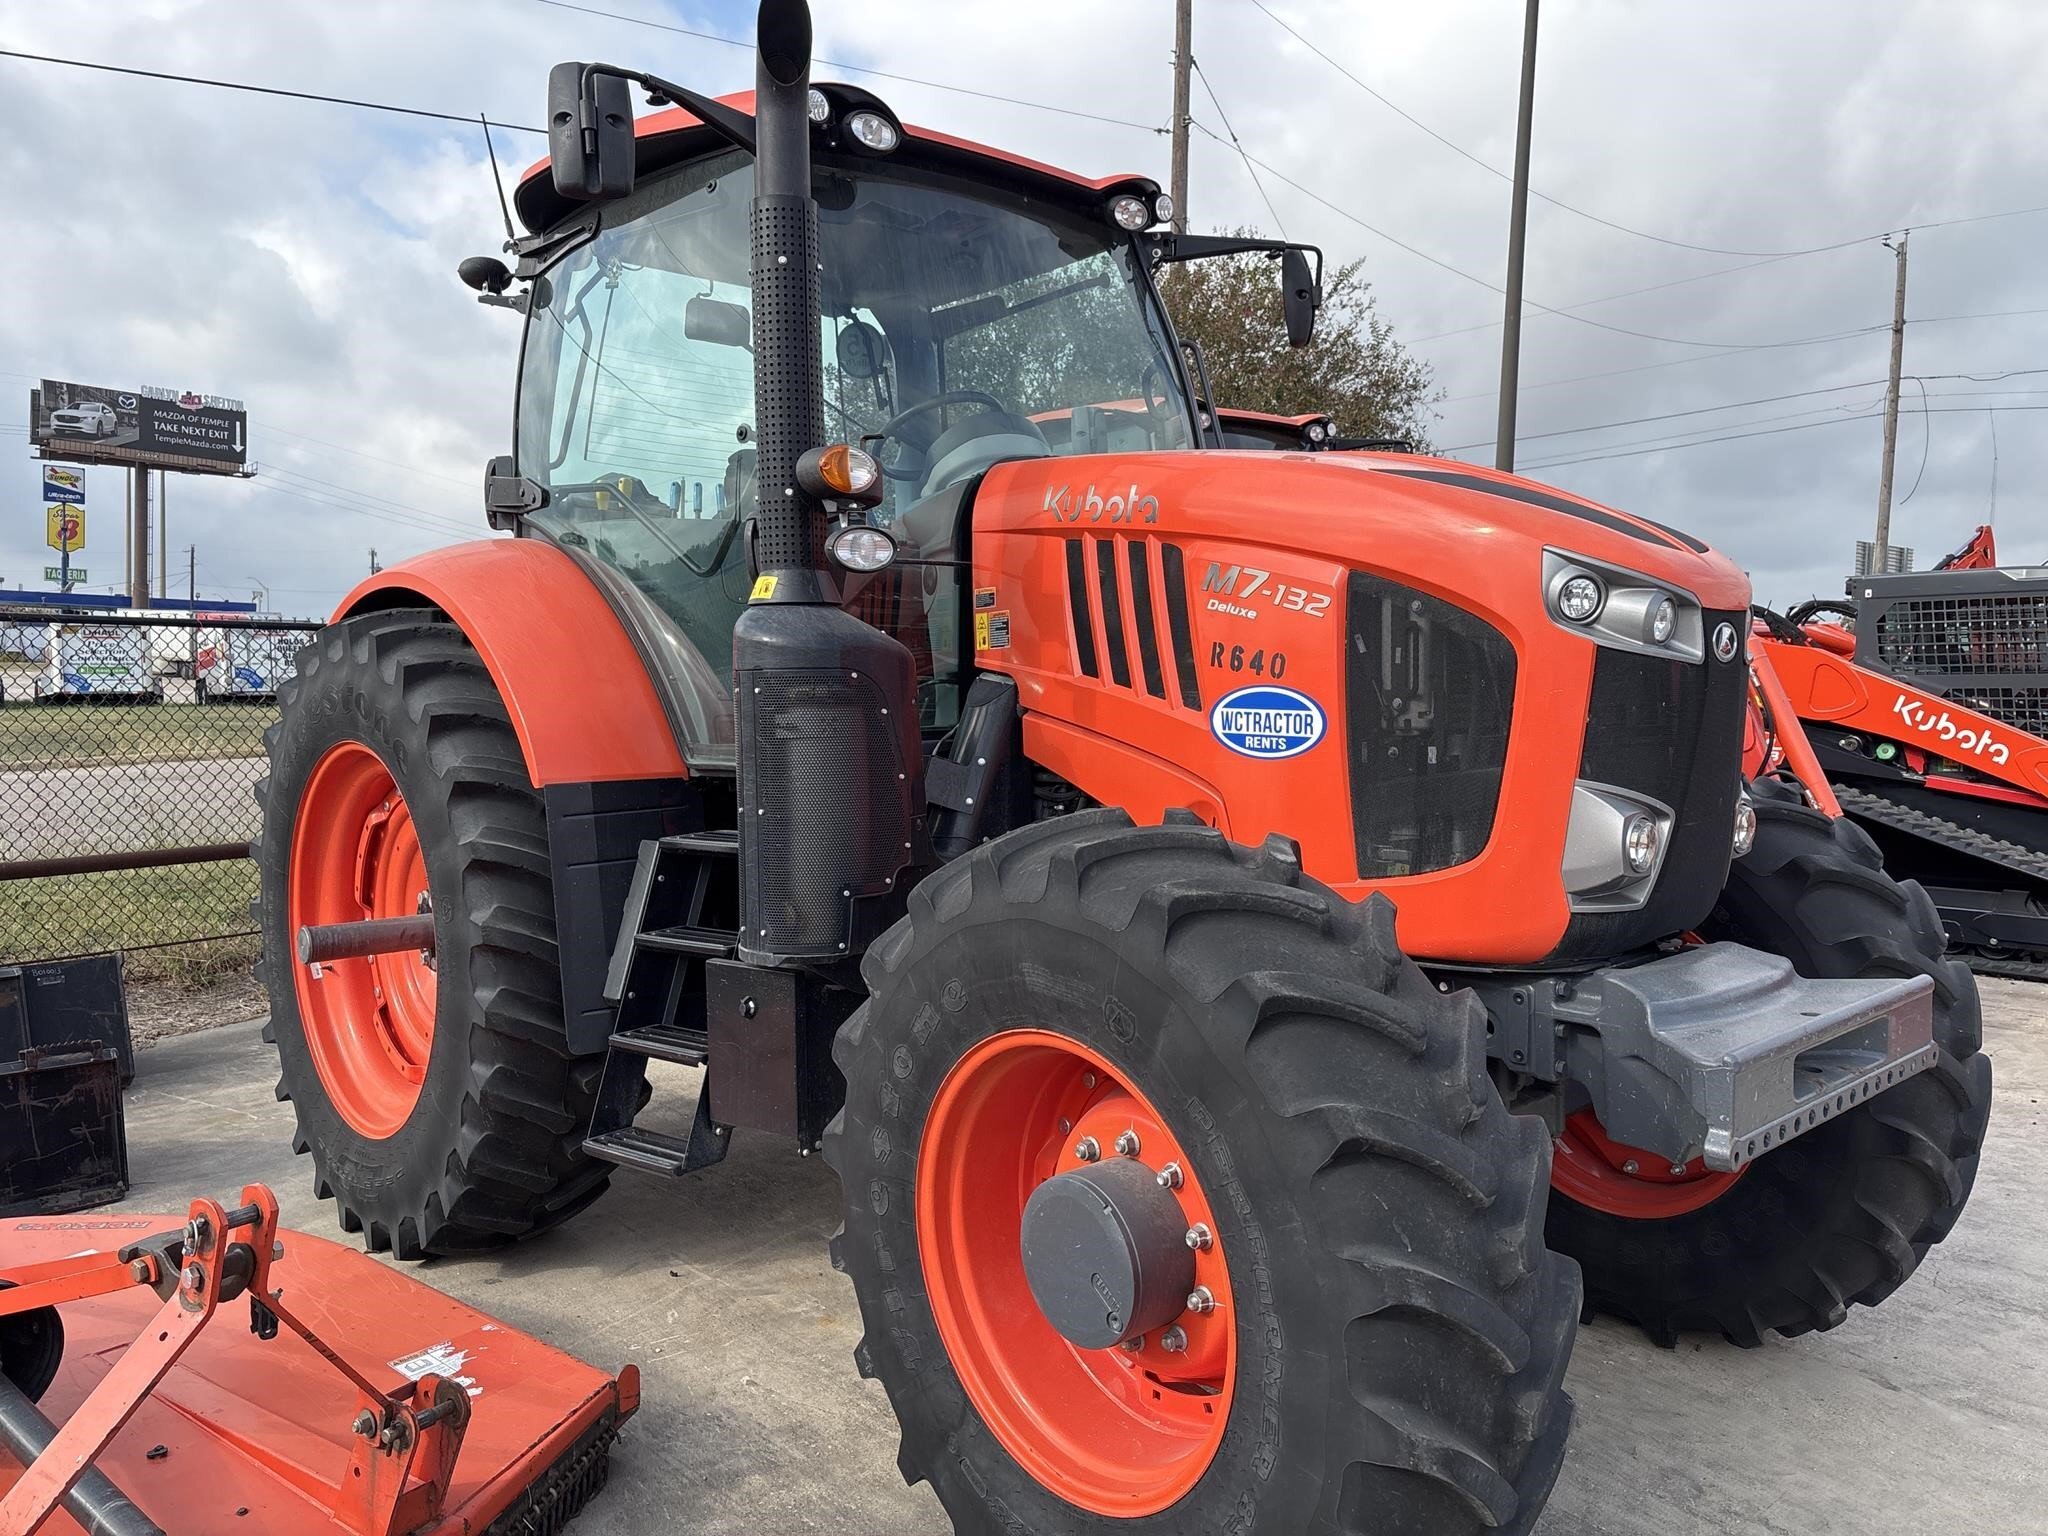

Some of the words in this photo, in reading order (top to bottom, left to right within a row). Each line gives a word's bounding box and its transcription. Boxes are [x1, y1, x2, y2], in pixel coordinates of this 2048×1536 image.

[153, 410, 186, 421] MAZDA
[187, 414, 199, 423] OF
[201, 416, 230, 428] TEMPLE
[153, 421, 179, 433] TAKE
[181, 425, 206, 437] NEXT
[208, 429, 229, 440] EXIT
[154, 433, 229, 451] TempleMazda.com
[47, 473, 80, 483] SUNOCO
[1042, 484, 1160, 524] Kubota
[56, 518, 80, 541] 8
[46, 568, 86, 581] TAQERIA
[1201, 561, 1332, 618] M7-132
[1207, 598, 1258, 620] Deluxe
[1210, 641, 1287, 680] R640
[1220, 711, 1315, 736] WCTRACTOR
[1892, 694, 2010, 766] Kubota
[1245, 736, 1287, 751] RENTS
